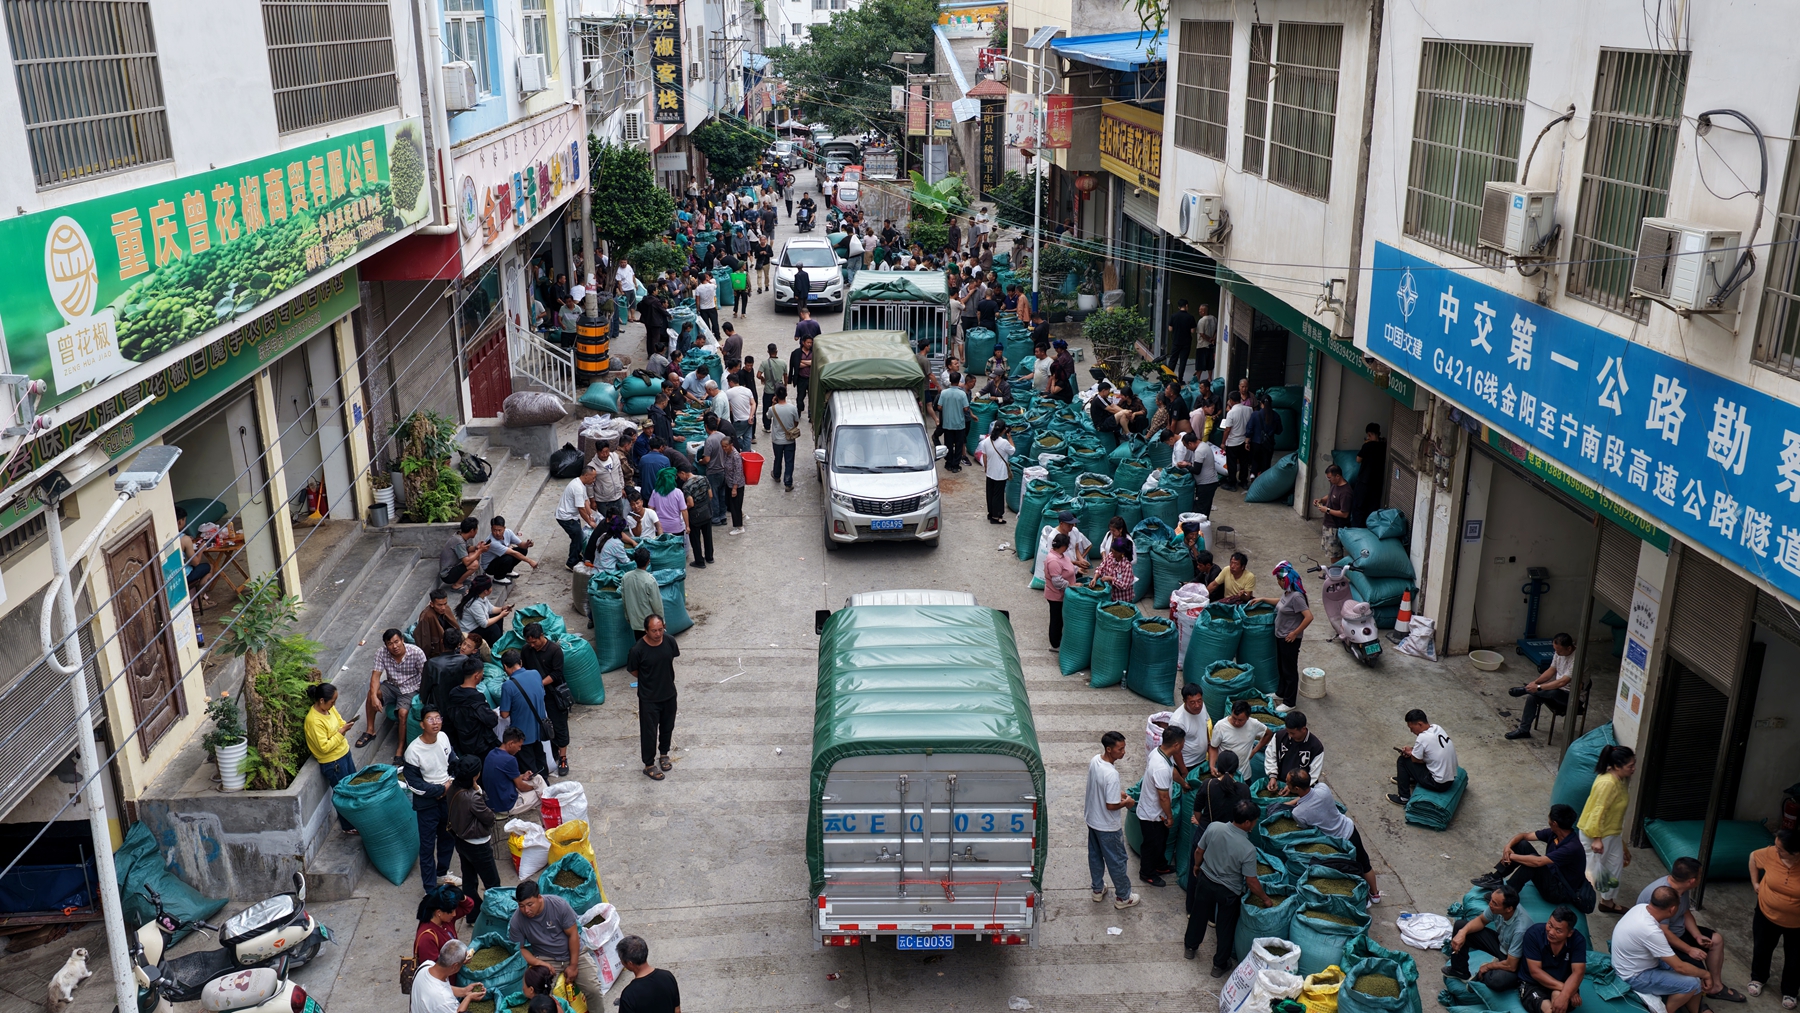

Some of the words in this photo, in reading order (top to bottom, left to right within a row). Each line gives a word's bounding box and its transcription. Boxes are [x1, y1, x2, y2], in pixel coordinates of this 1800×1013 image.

[654, 9, 679, 110] 花椒客栈
[110, 139, 379, 281] 重庆曾花椒商贸有限公司
[57, 322, 111, 366] 曾花椒
[64, 363, 82, 377] ZENG
[83, 358, 97, 368] HUA
[98, 350, 112, 363] JIAO
[1384, 323, 1424, 361] 中国交建
